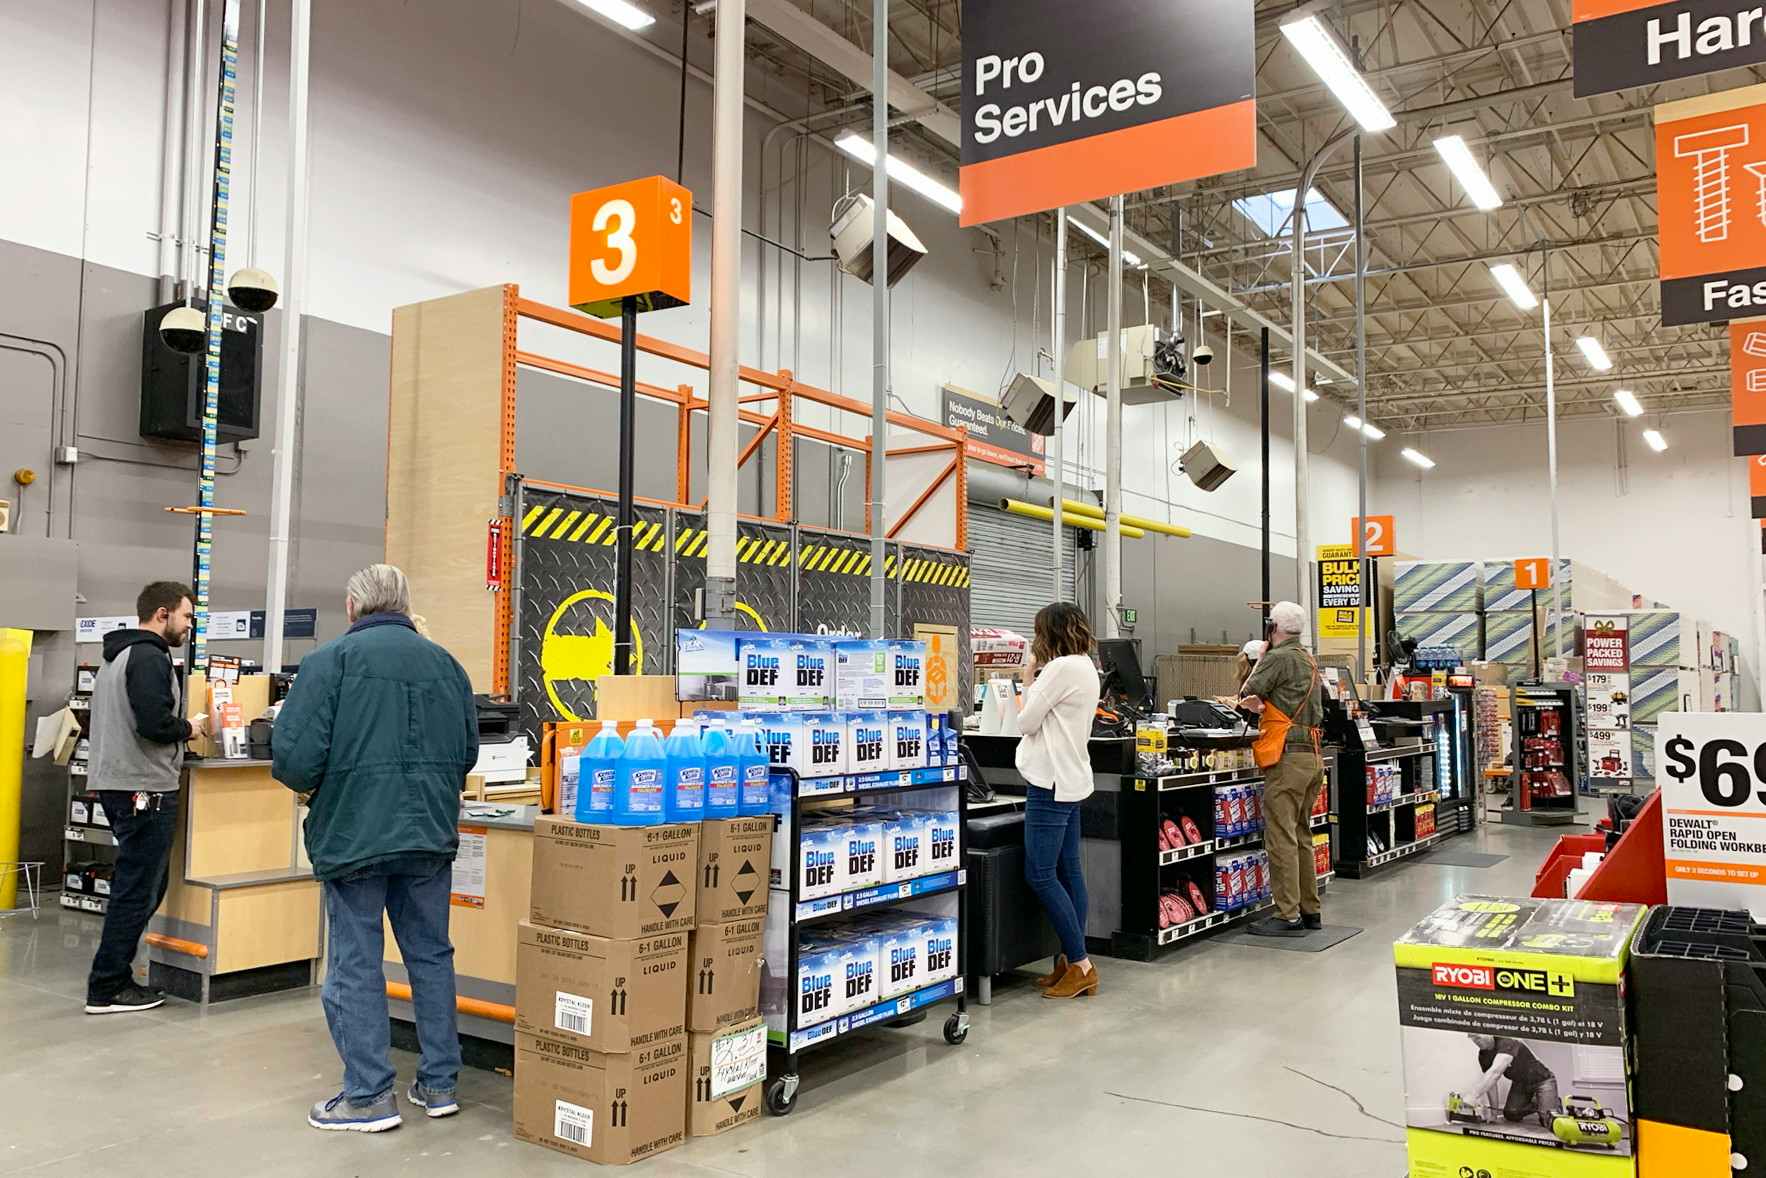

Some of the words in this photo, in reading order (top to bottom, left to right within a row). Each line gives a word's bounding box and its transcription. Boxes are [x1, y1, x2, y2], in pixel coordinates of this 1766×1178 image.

[1647, 7, 1766, 65] Har
[975, 51, 1044, 96] Pro
[974, 72, 1162, 144] Services
[669, 197, 682, 224] 3
[591, 199, 637, 286] 3
[949, 400, 976, 420] Nobody
[976, 409, 994, 424] Beats
[1363, 521, 1383, 551] 2
[1322, 574, 1360, 585] PRIC
[1524, 562, 1537, 585] 1
[1323, 585, 1359, 593] SAVING
[1323, 598, 1348, 606] EVERY
[1350, 598, 1360, 606] DA
[1587, 637, 1622, 648] POWER
[747, 654, 779, 669] Blue
[796, 654, 824, 669] Blue
[1587, 648, 1622, 658] PACKED
[895, 655, 920, 669] Blue
[1587, 658, 1623, 667] SAVINGS
[747, 669, 779, 685] DEF
[796, 670, 824, 686] DEF
[895, 670, 919, 686] DEF
[812, 730, 840, 744] Blue
[856, 729, 882, 743] Blue
[897, 727, 920, 741] Blue
[812, 744, 839, 763] DEF
[857, 742, 882, 761] DEF
[897, 741, 920, 758] DEF
[1665, 734, 1766, 807] $6
[551, 824, 574, 837] PLASTIC
[575, 828, 601, 841] BOTTLES
[662, 828, 692, 841] GALLON
[743, 821, 767, 833] GALLON
[932, 827, 955, 844] Blue
[1670, 829, 1704, 840] RAPID
[1707, 830, 1736, 841] OPEN
[733, 843, 762, 853] LIQUID
[849, 840, 876, 857] Blue
[894, 835, 919, 852] Blue
[932, 841, 954, 860] DEF
[1670, 839, 1717, 851] FOLDING
[652, 852, 686, 864] LIQUID
[709, 853, 719, 862] UP
[806, 849, 835, 868] Blue
[848, 854, 875, 875] DEF
[895, 850, 918, 870] DEF
[625, 864, 636, 874] UP
[806, 867, 834, 887] DEF
[1697, 867, 1726, 876] SECONDS
[1727, 869, 1736, 877] TO
[1737, 870, 1748, 878] SET
[1749, 871, 1760, 879] UP
[812, 903, 826, 912] Blue
[827, 900, 837, 910] DEF
[641, 922, 665, 934] HANDLE
[665, 919, 679, 929] WITH
[680, 916, 694, 926] CARE
[736, 921, 760, 934] GALLON
[536, 933, 561, 946] PLASTIC
[562, 936, 589, 952] BOTTLES
[653, 936, 682, 949] GALLON
[928, 937, 952, 957] Blue
[728, 946, 754, 957] LIQUID
[891, 946, 916, 964] Blue
[643, 961, 676, 975] LIQUID
[703, 958, 713, 968] UP
[846, 960, 873, 979] Blue
[928, 951, 951, 971] DEF
[891, 962, 916, 982] DEF
[1434, 966, 1490, 985] RYOBI
[615, 977, 626, 987] UP
[801, 974, 832, 993] Blue
[846, 975, 873, 999] DEF
[801, 989, 831, 1013] DEF
[1452, 994, 1481, 1004] GALLON
[1482, 997, 1530, 1008] COMPRESSOR
[1532, 1001, 1560, 1011] COMBO
[1561, 1004, 1574, 1012] KIT
[1410, 1004, 1442, 1014] Ensemble
[1473, 1011, 1517, 1021] compresseur
[1413, 1014, 1432, 1023] Juego
[1434, 1016, 1471, 1026] combinado
[1482, 1021, 1519, 1031] compresor
[631, 1032, 654, 1047] HANDLE
[654, 1029, 668, 1040] WITH
[669, 1025, 683, 1035] CARE
[536, 1039, 561, 1054] PLASTIC
[562, 1045, 589, 1062] BOTTLES
[653, 1042, 682, 1060] GALLON
[643, 1068, 676, 1085] LIQUID
[700, 1066, 710, 1076] UP
[615, 1088, 626, 1099] UP
[1580, 1122, 1609, 1132] RYOBI
[631, 1143, 653, 1157] HANDLE
[654, 1137, 668, 1150] WITH
[669, 1131, 682, 1144] CARE
